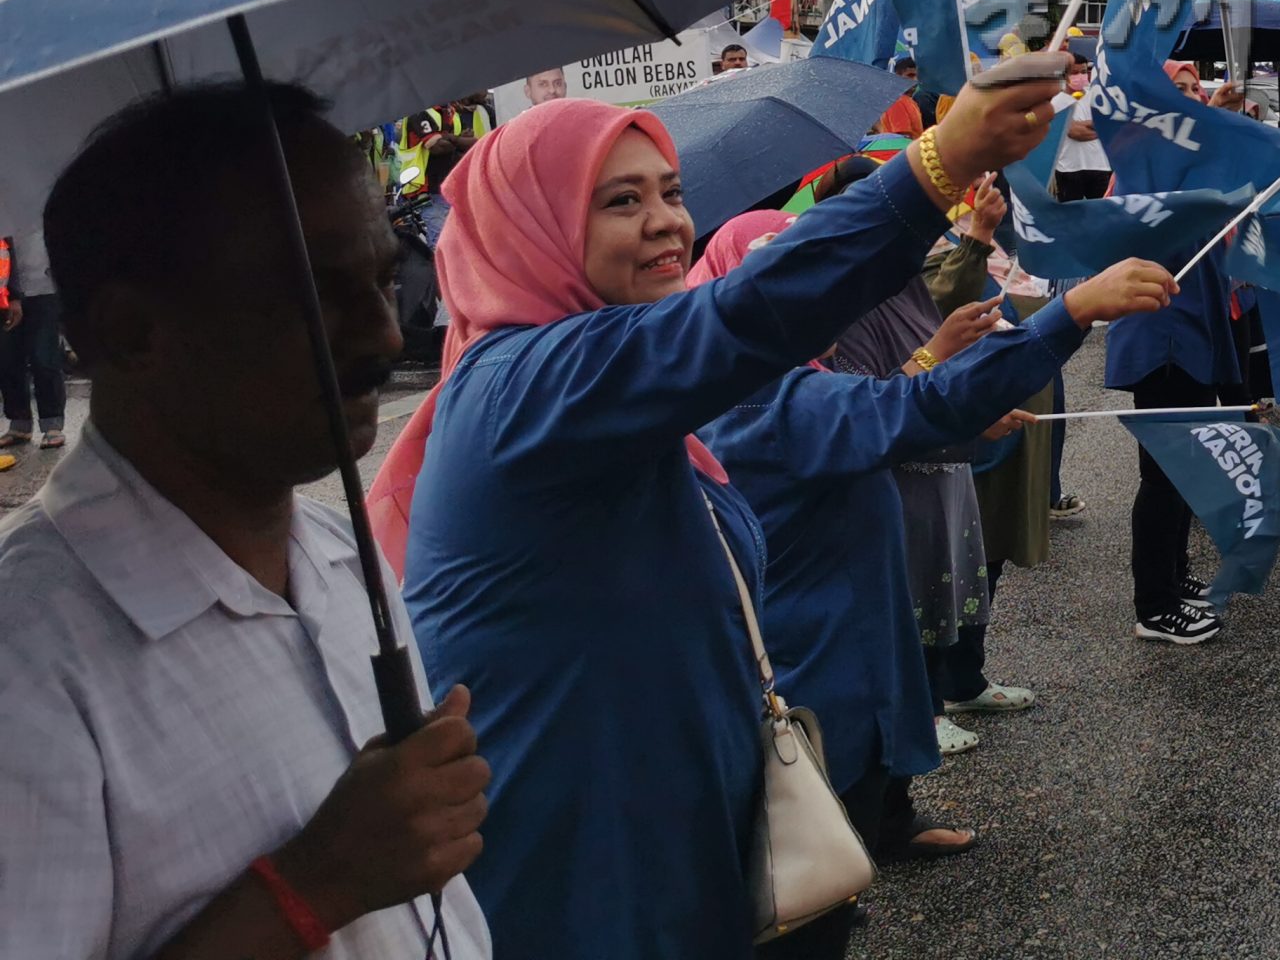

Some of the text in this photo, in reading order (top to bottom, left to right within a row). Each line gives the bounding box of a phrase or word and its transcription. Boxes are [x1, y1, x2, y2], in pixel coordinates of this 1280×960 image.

[582, 60, 697, 90] CALON BEBAS
[420, 120, 432, 133] 3
